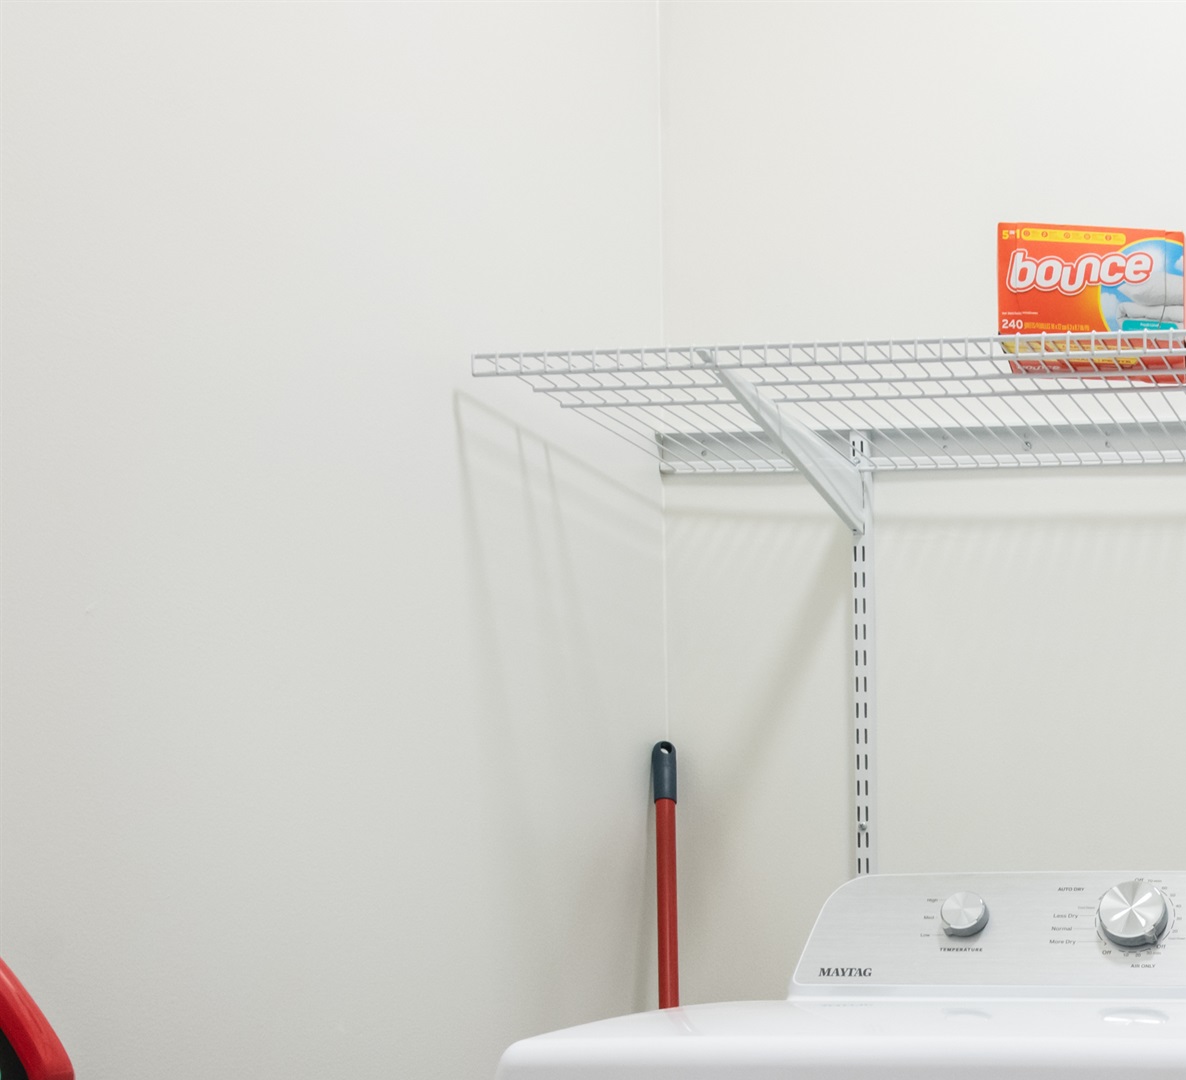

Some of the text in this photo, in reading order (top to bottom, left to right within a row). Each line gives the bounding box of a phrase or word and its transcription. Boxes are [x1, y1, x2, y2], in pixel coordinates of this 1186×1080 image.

[1007, 249, 1153, 293] bounce
[1002, 319, 1023, 329] 240
[818, 967, 872, 977] MAYTAG
